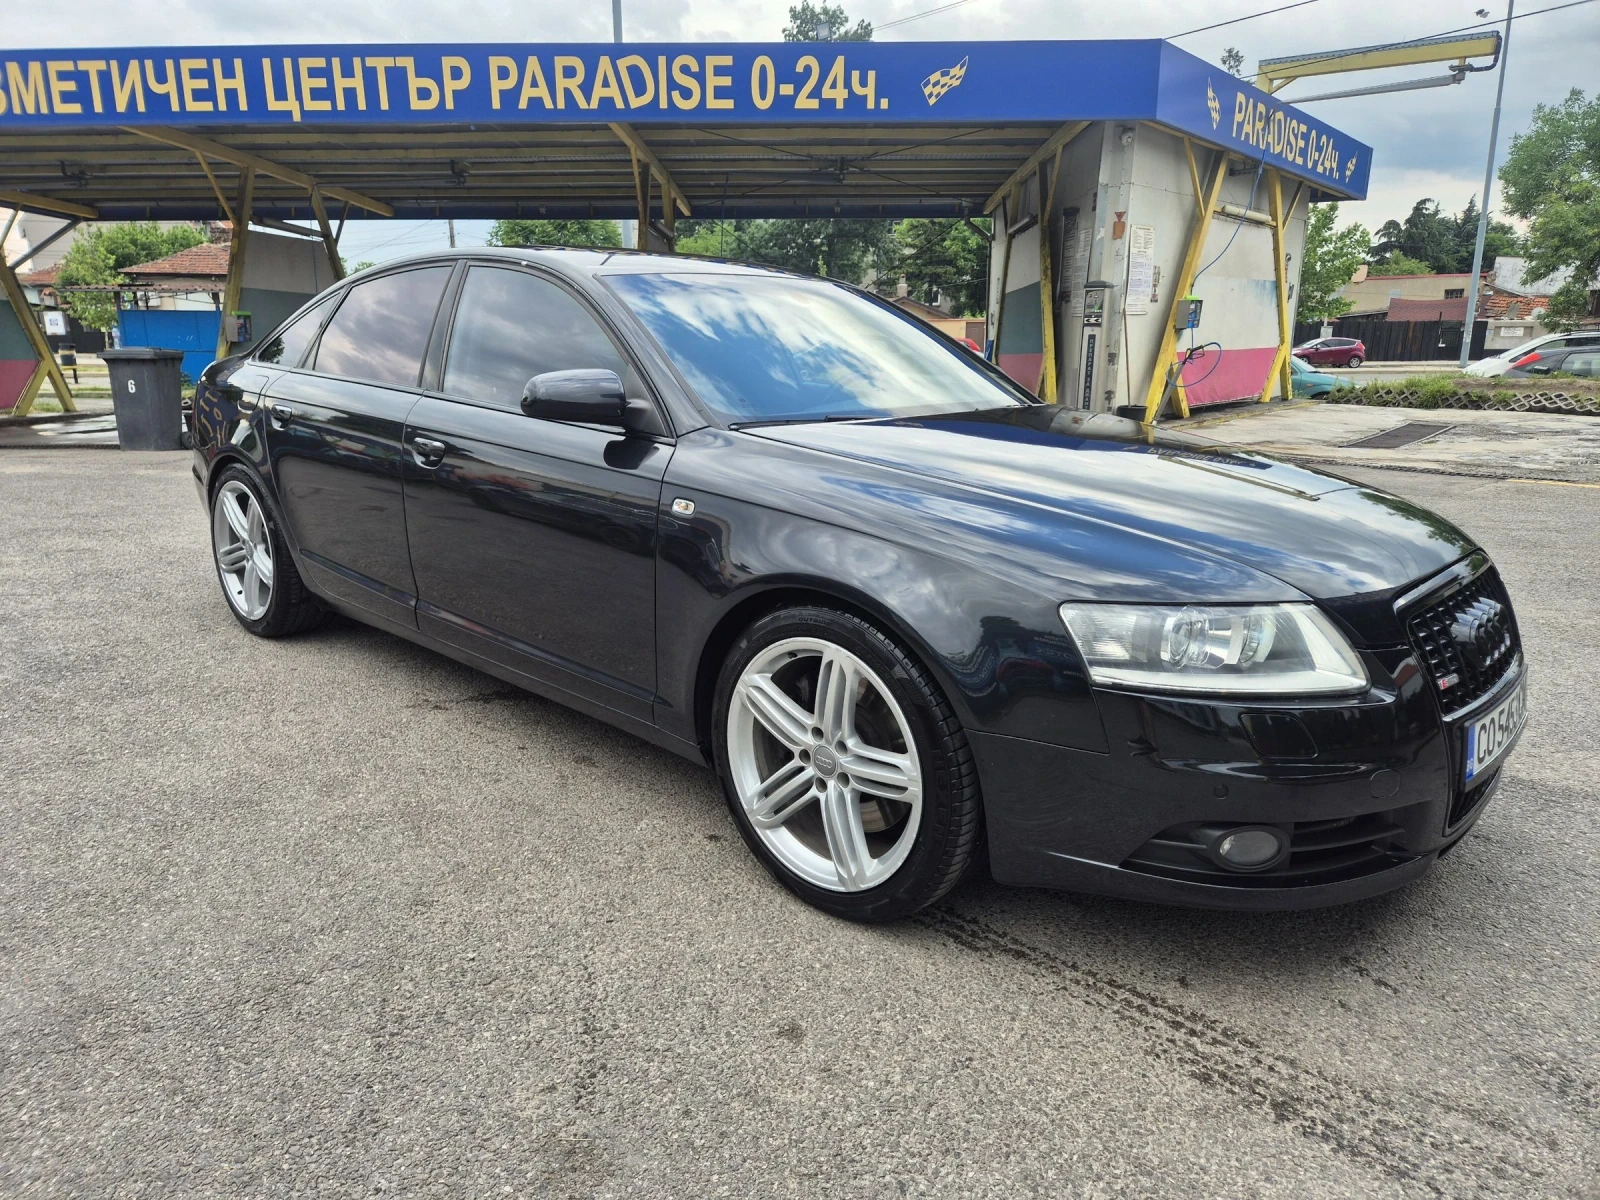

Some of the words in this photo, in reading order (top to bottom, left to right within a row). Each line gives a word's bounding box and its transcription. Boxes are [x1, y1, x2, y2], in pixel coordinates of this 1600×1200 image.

[0, 58, 247, 115] МЕТИЧЕН
[262, 56, 471, 121] ЦЕНТЪР
[488, 54, 734, 110] PARADISE
[751, 55, 889, 110] 0-24ч.
[1232, 91, 1307, 166] PARADISE
[127, 379, 136, 393] 6
